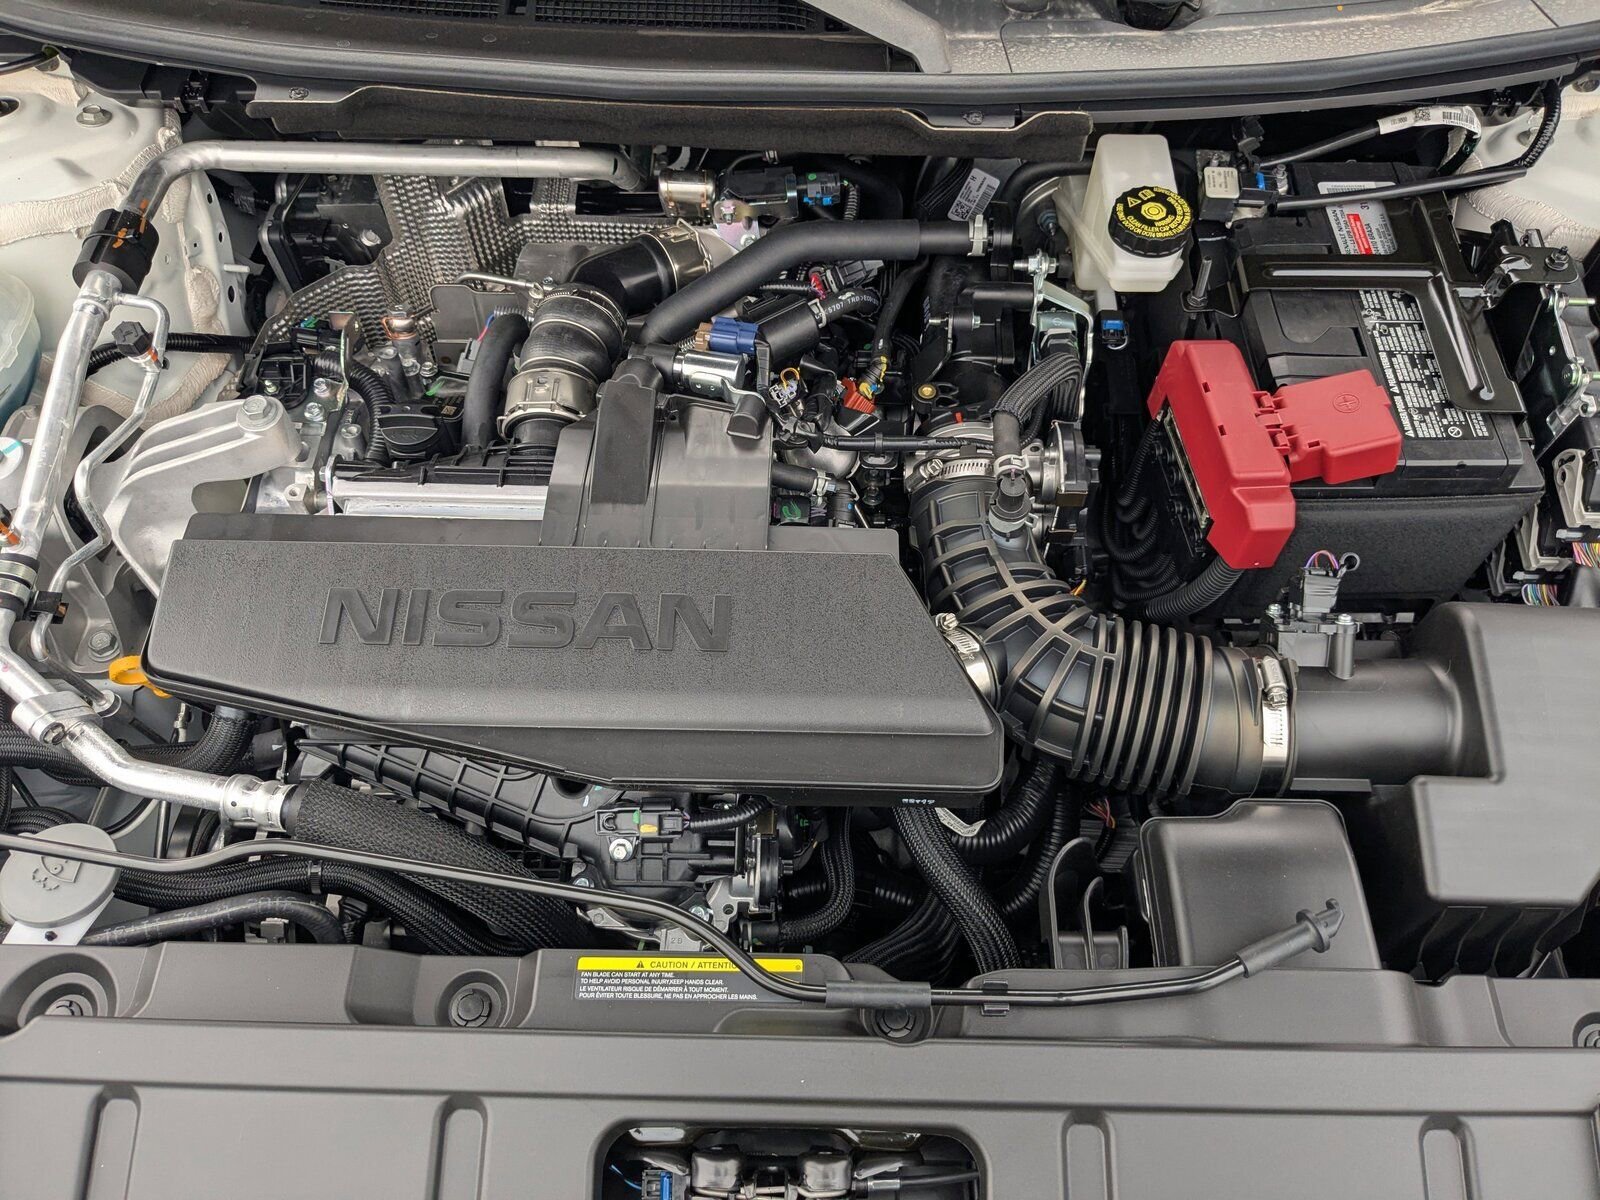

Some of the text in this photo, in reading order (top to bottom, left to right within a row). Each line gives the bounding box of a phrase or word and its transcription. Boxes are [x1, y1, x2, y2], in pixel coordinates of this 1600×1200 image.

[1127, 216, 1142, 228] CLEAN
[1141, 224, 1159, 232] FILLER
[318, 586, 733, 652] NISSAN
